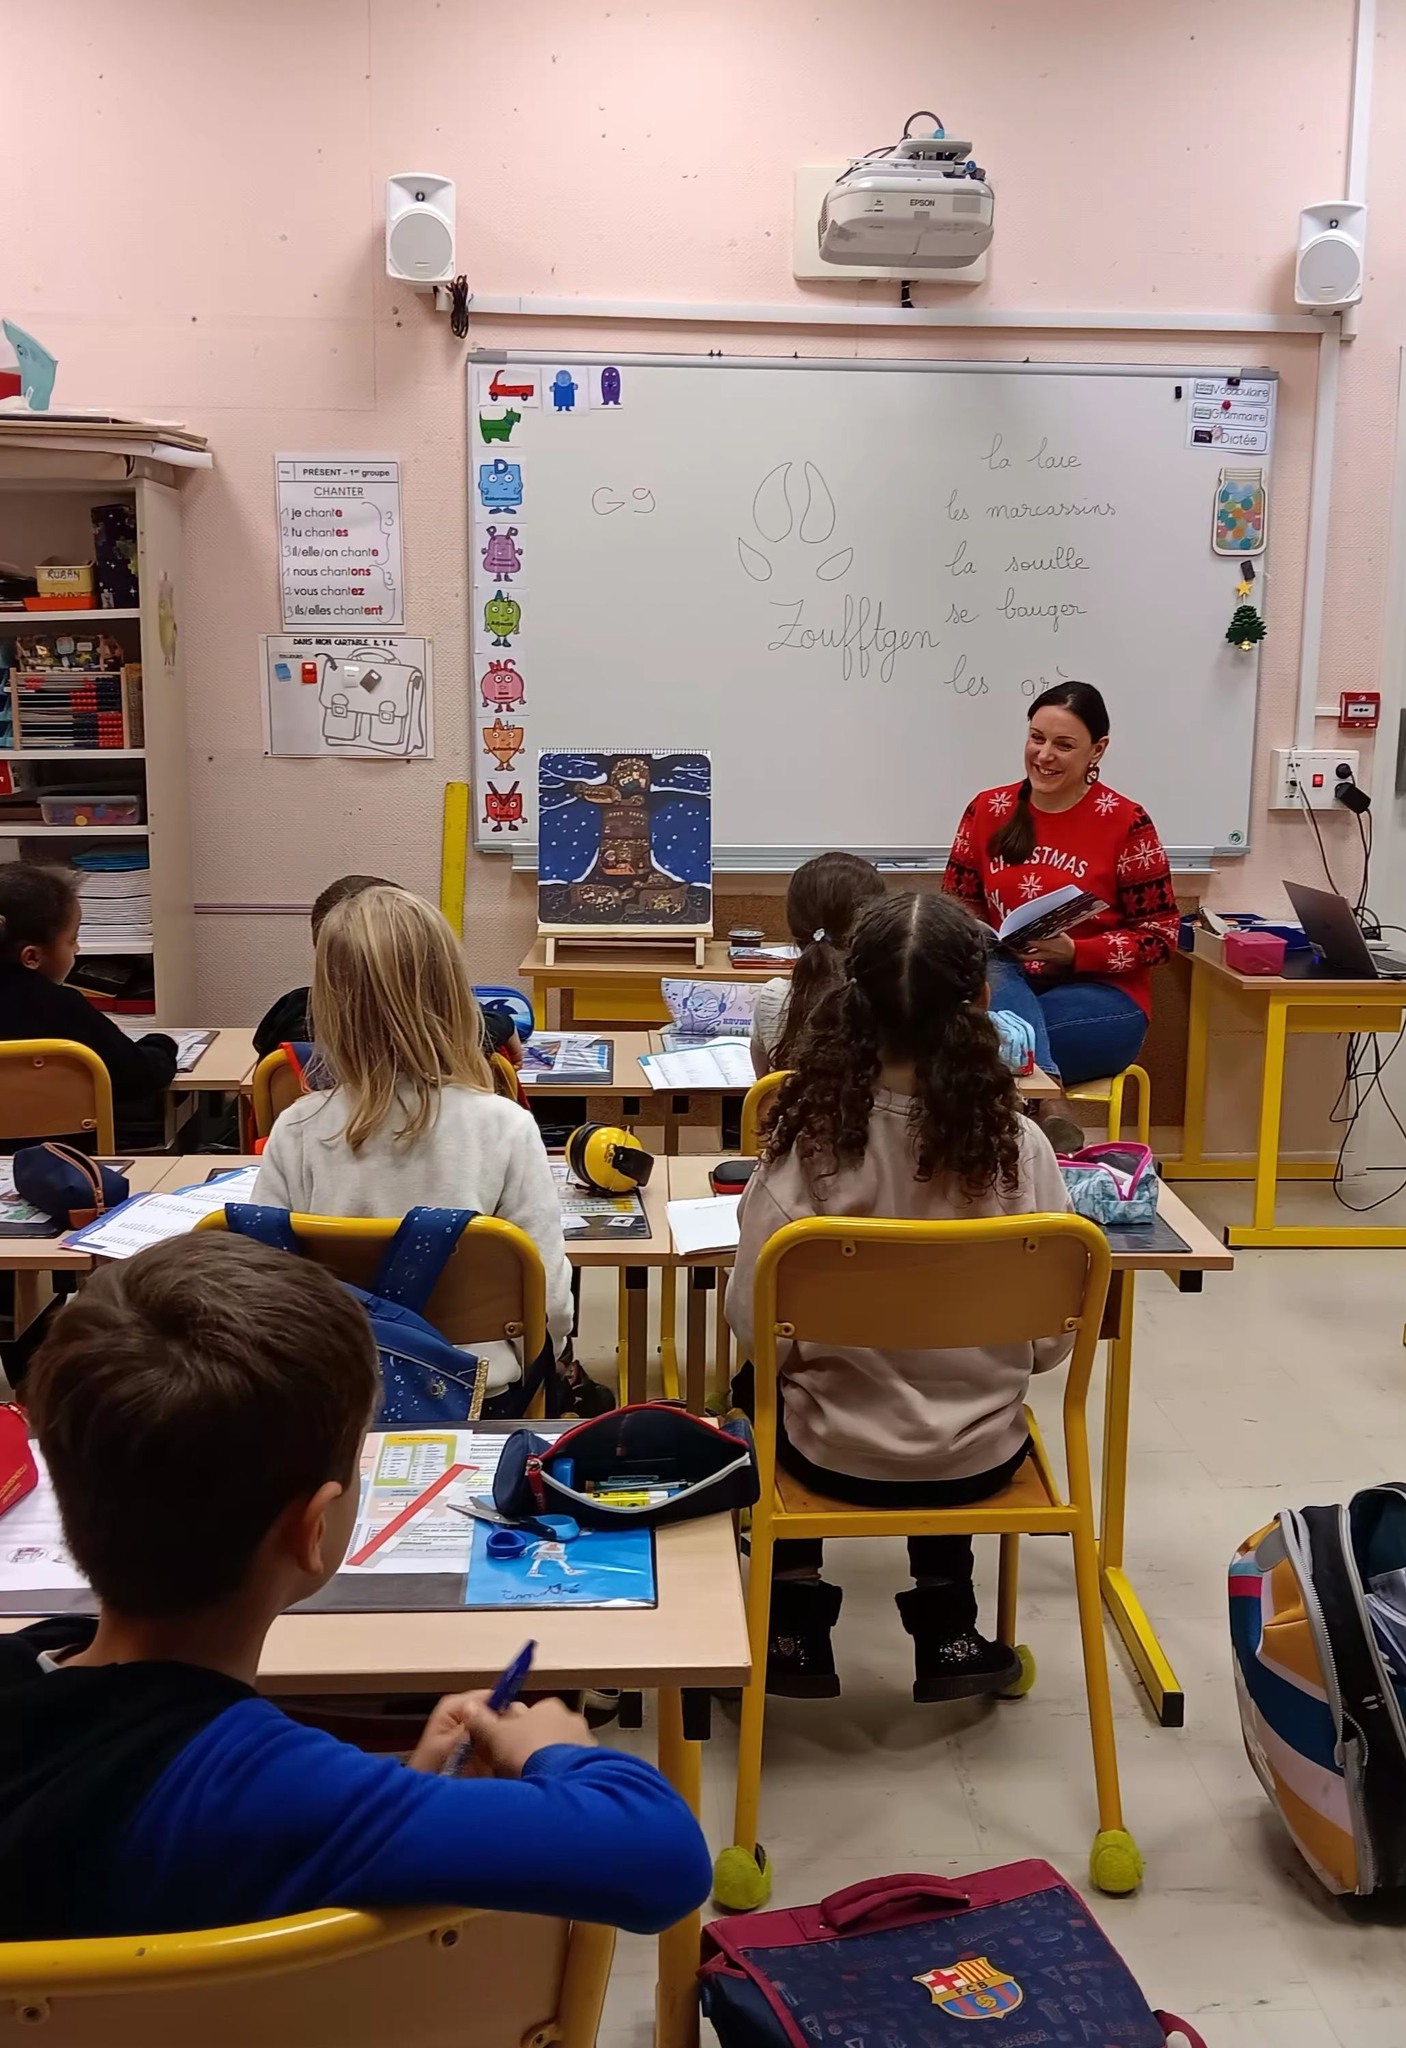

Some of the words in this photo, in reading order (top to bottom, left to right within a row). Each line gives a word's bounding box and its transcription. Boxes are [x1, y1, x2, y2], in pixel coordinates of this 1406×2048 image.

[909, 199, 935, 207] EPSON
[1211, 408, 1265, 422] Grammaire
[1220, 432, 1257, 445] Dictée
[980, 433, 1011, 470] la
[303, 468, 341, 476] PRÉSENT
[361, 470, 390, 478] groupe
[313, 486, 364, 496] CHANTER
[945, 489, 970, 521] les
[986, 497, 1117, 520] marcassins
[291, 508, 302, 520] je
[304, 507, 343, 518] chante
[291, 527, 302, 537] tu
[304, 526, 349, 537] chantes
[340, 546, 379, 557] chante
[945, 540, 977, 576] la
[1004, 546, 1091, 573] souille
[47, 569, 80, 581] RUBAN
[293, 568, 318, 577] nous
[320, 566, 371, 577] chantons
[293, 587, 318, 596] vous
[320, 586, 365, 596] chantez
[333, 605, 383, 616] chantent
[945, 603, 980, 624] se
[767, 594, 941, 684] Zoufftgen
[944, 655, 989, 697] les
[955, 1981, 989, 1995] FCB
